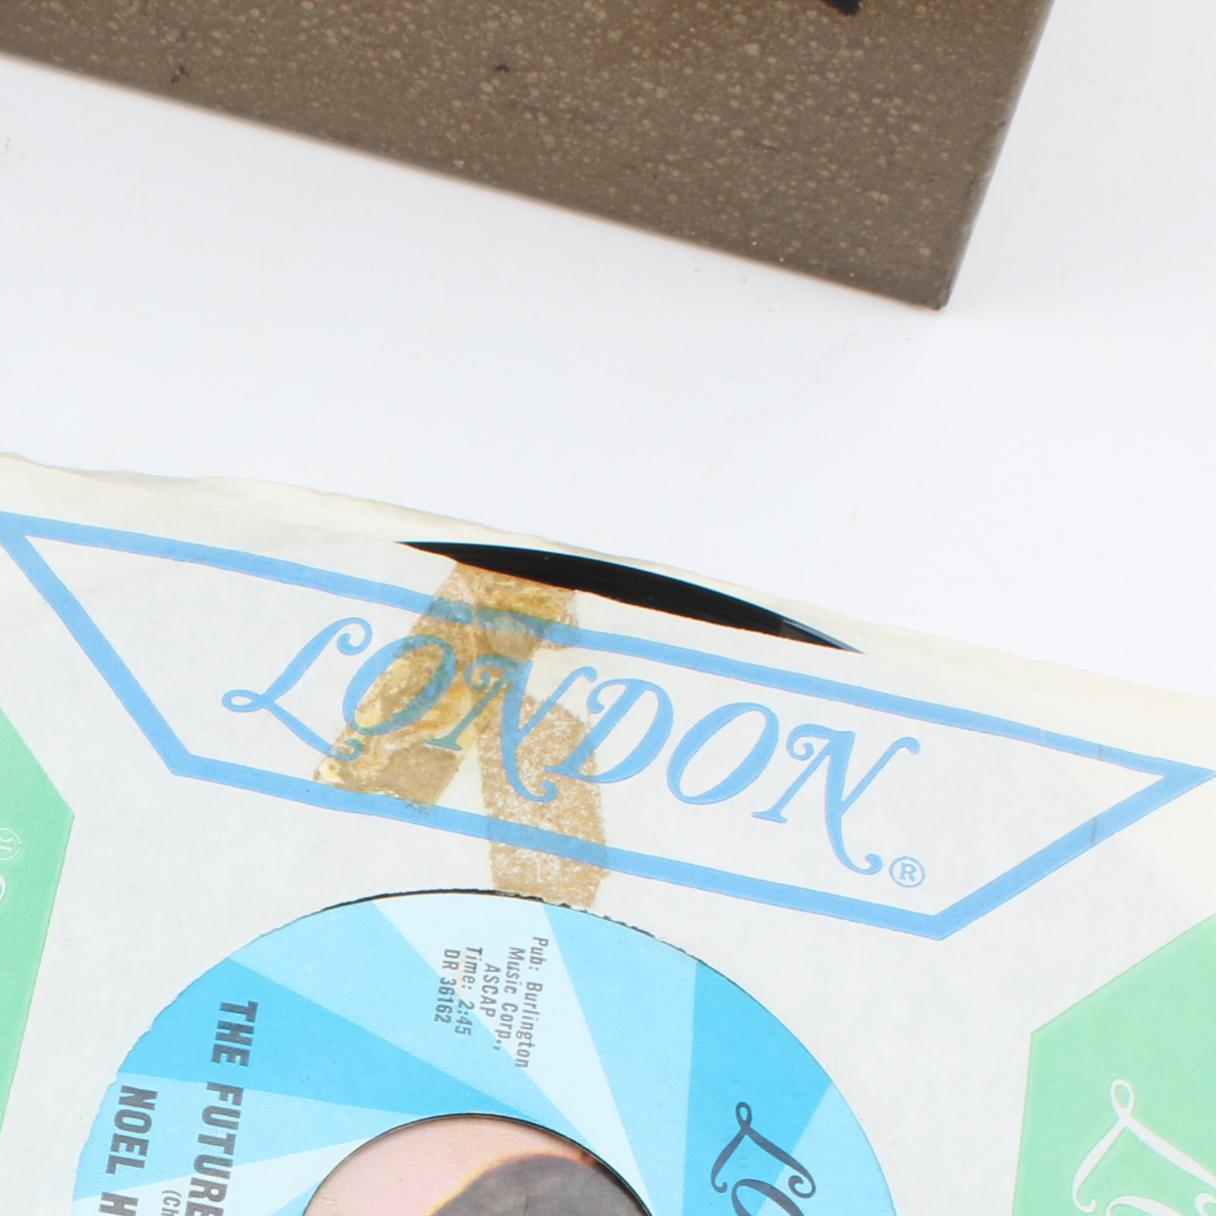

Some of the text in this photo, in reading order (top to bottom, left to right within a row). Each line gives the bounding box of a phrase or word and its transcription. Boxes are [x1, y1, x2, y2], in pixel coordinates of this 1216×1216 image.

[221, 616, 920, 875] LONDON
[434, 948, 461, 1024] DR 36162
[454, 946, 483, 1036] Time: 2:45
[479, 962, 501, 1018] ASCAP
[503, 946, 526, 995] Music
[515, 936, 549, 1069] Pub: Burlington
[210, 1000, 259, 1067] THE
[105, 1084, 158, 1175] NOEL
